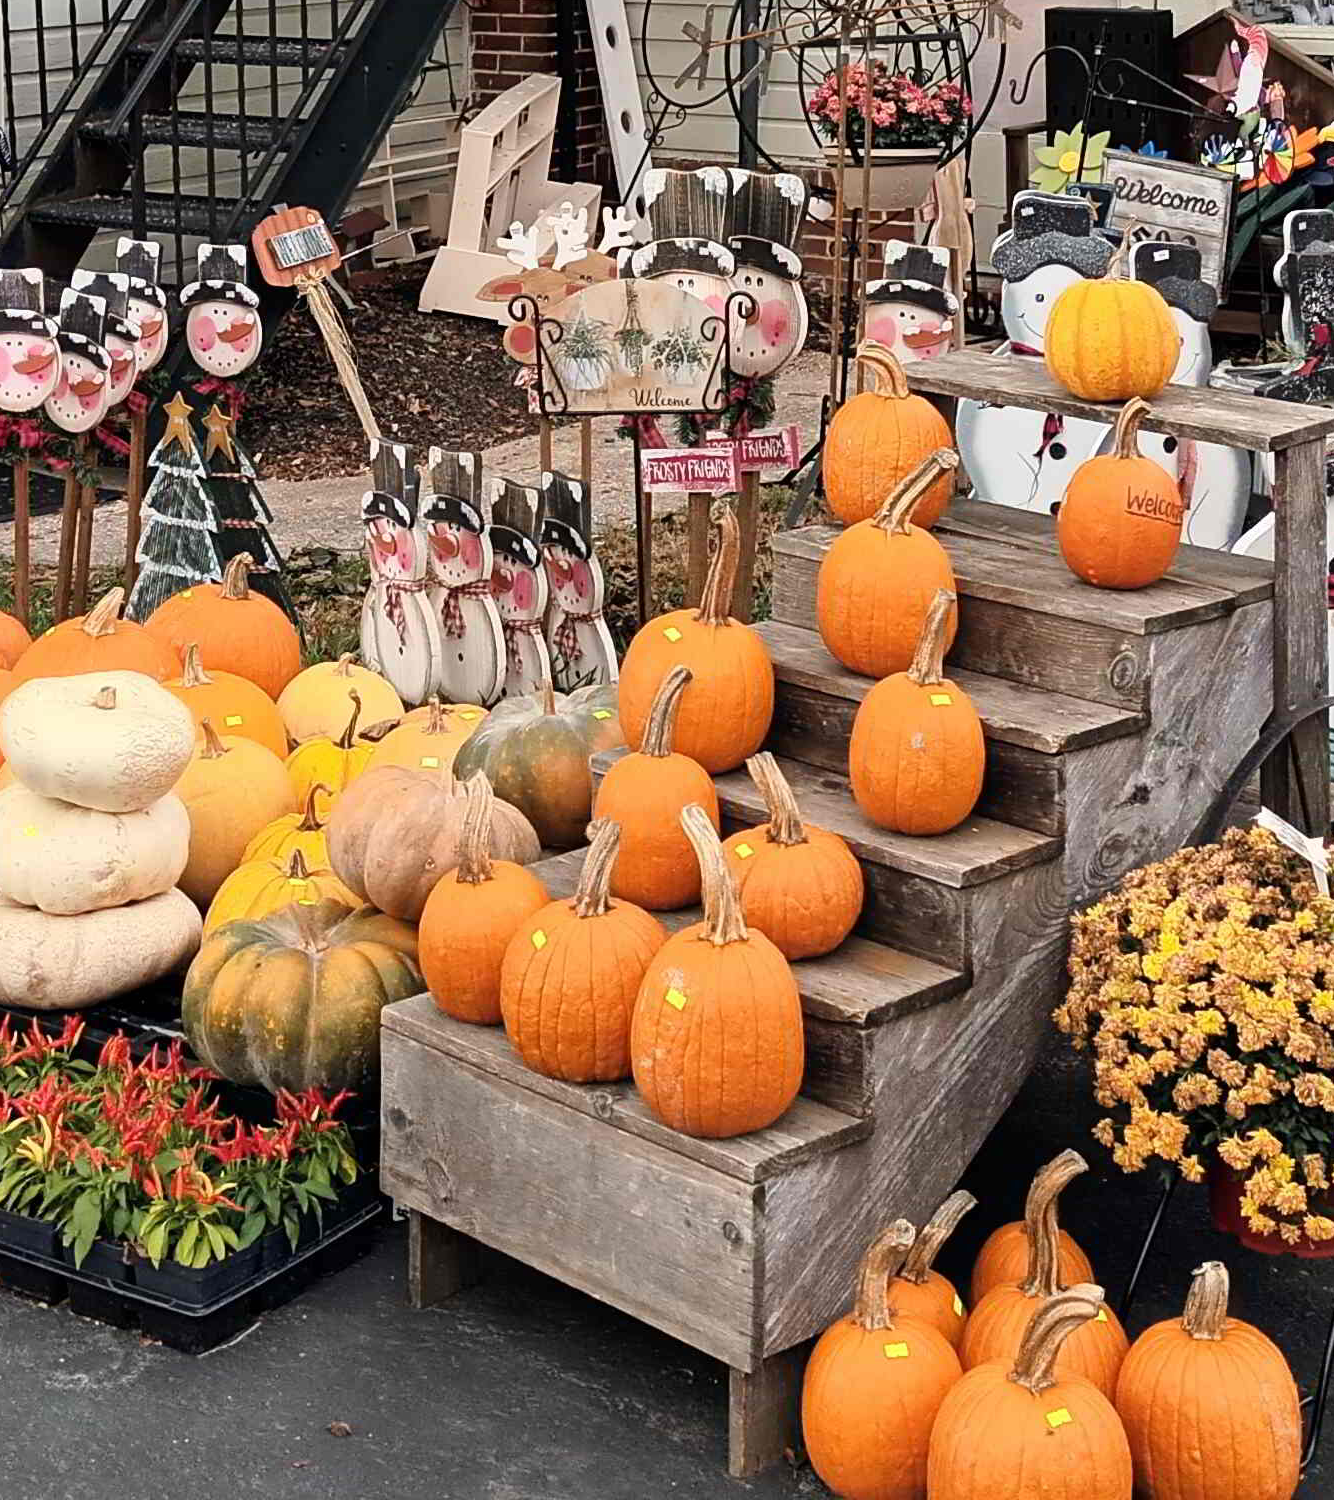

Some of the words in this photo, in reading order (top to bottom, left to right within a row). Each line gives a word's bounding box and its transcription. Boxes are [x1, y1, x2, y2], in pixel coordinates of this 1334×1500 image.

[1114, 176, 1220, 217] Welcome
[629, 387, 693, 408] Welcome
[741, 437, 787, 461] FRIENDS
[646, 459, 687, 481] FROSTY
[688, 459, 733, 480] FRIENDS
